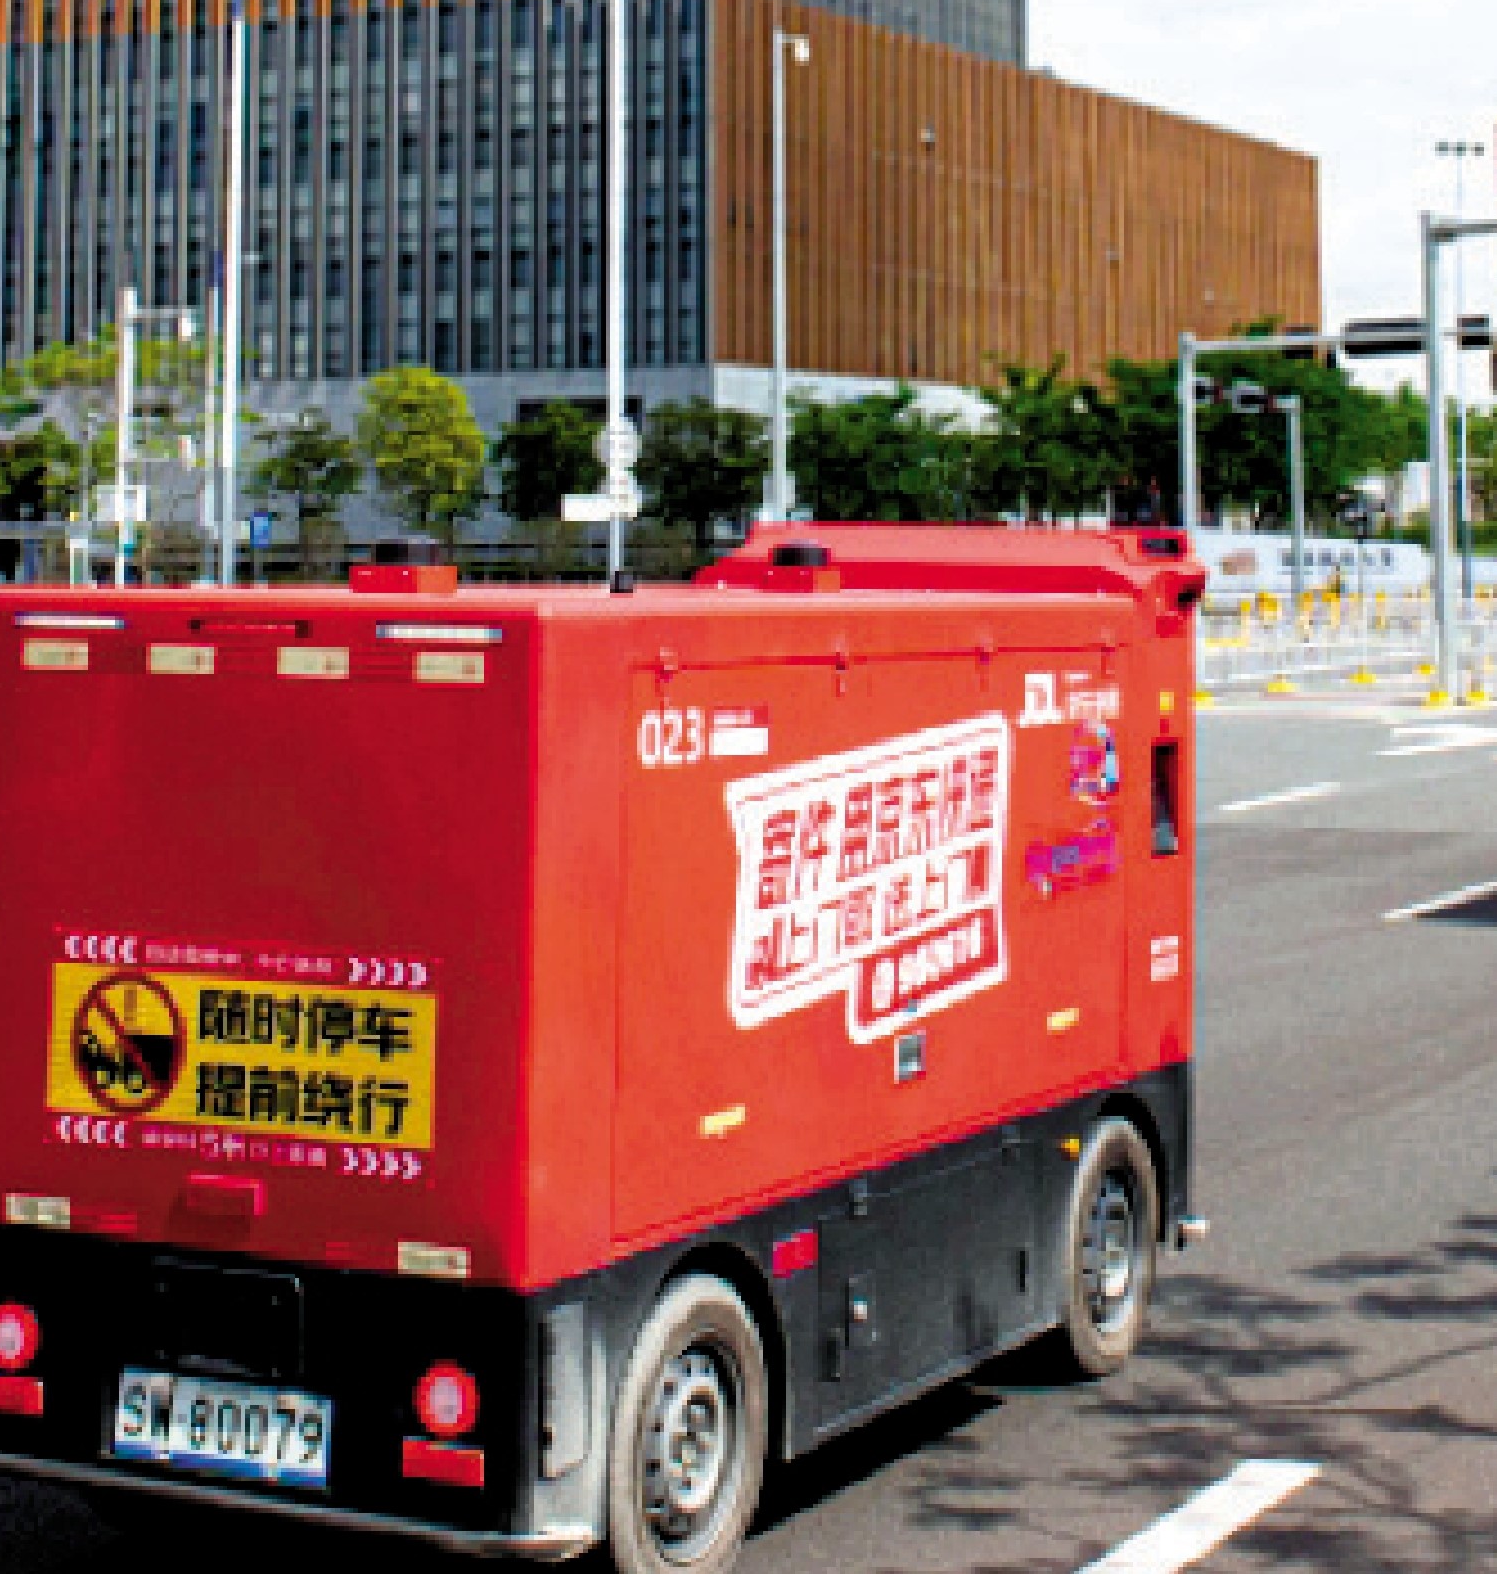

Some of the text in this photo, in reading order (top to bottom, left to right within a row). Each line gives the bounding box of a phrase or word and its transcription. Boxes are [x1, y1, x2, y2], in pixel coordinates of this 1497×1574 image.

[637, 707, 703, 766] 023
[197, 988, 412, 1060] 随时停车
[195, 1062, 409, 1138] 提前绕行
